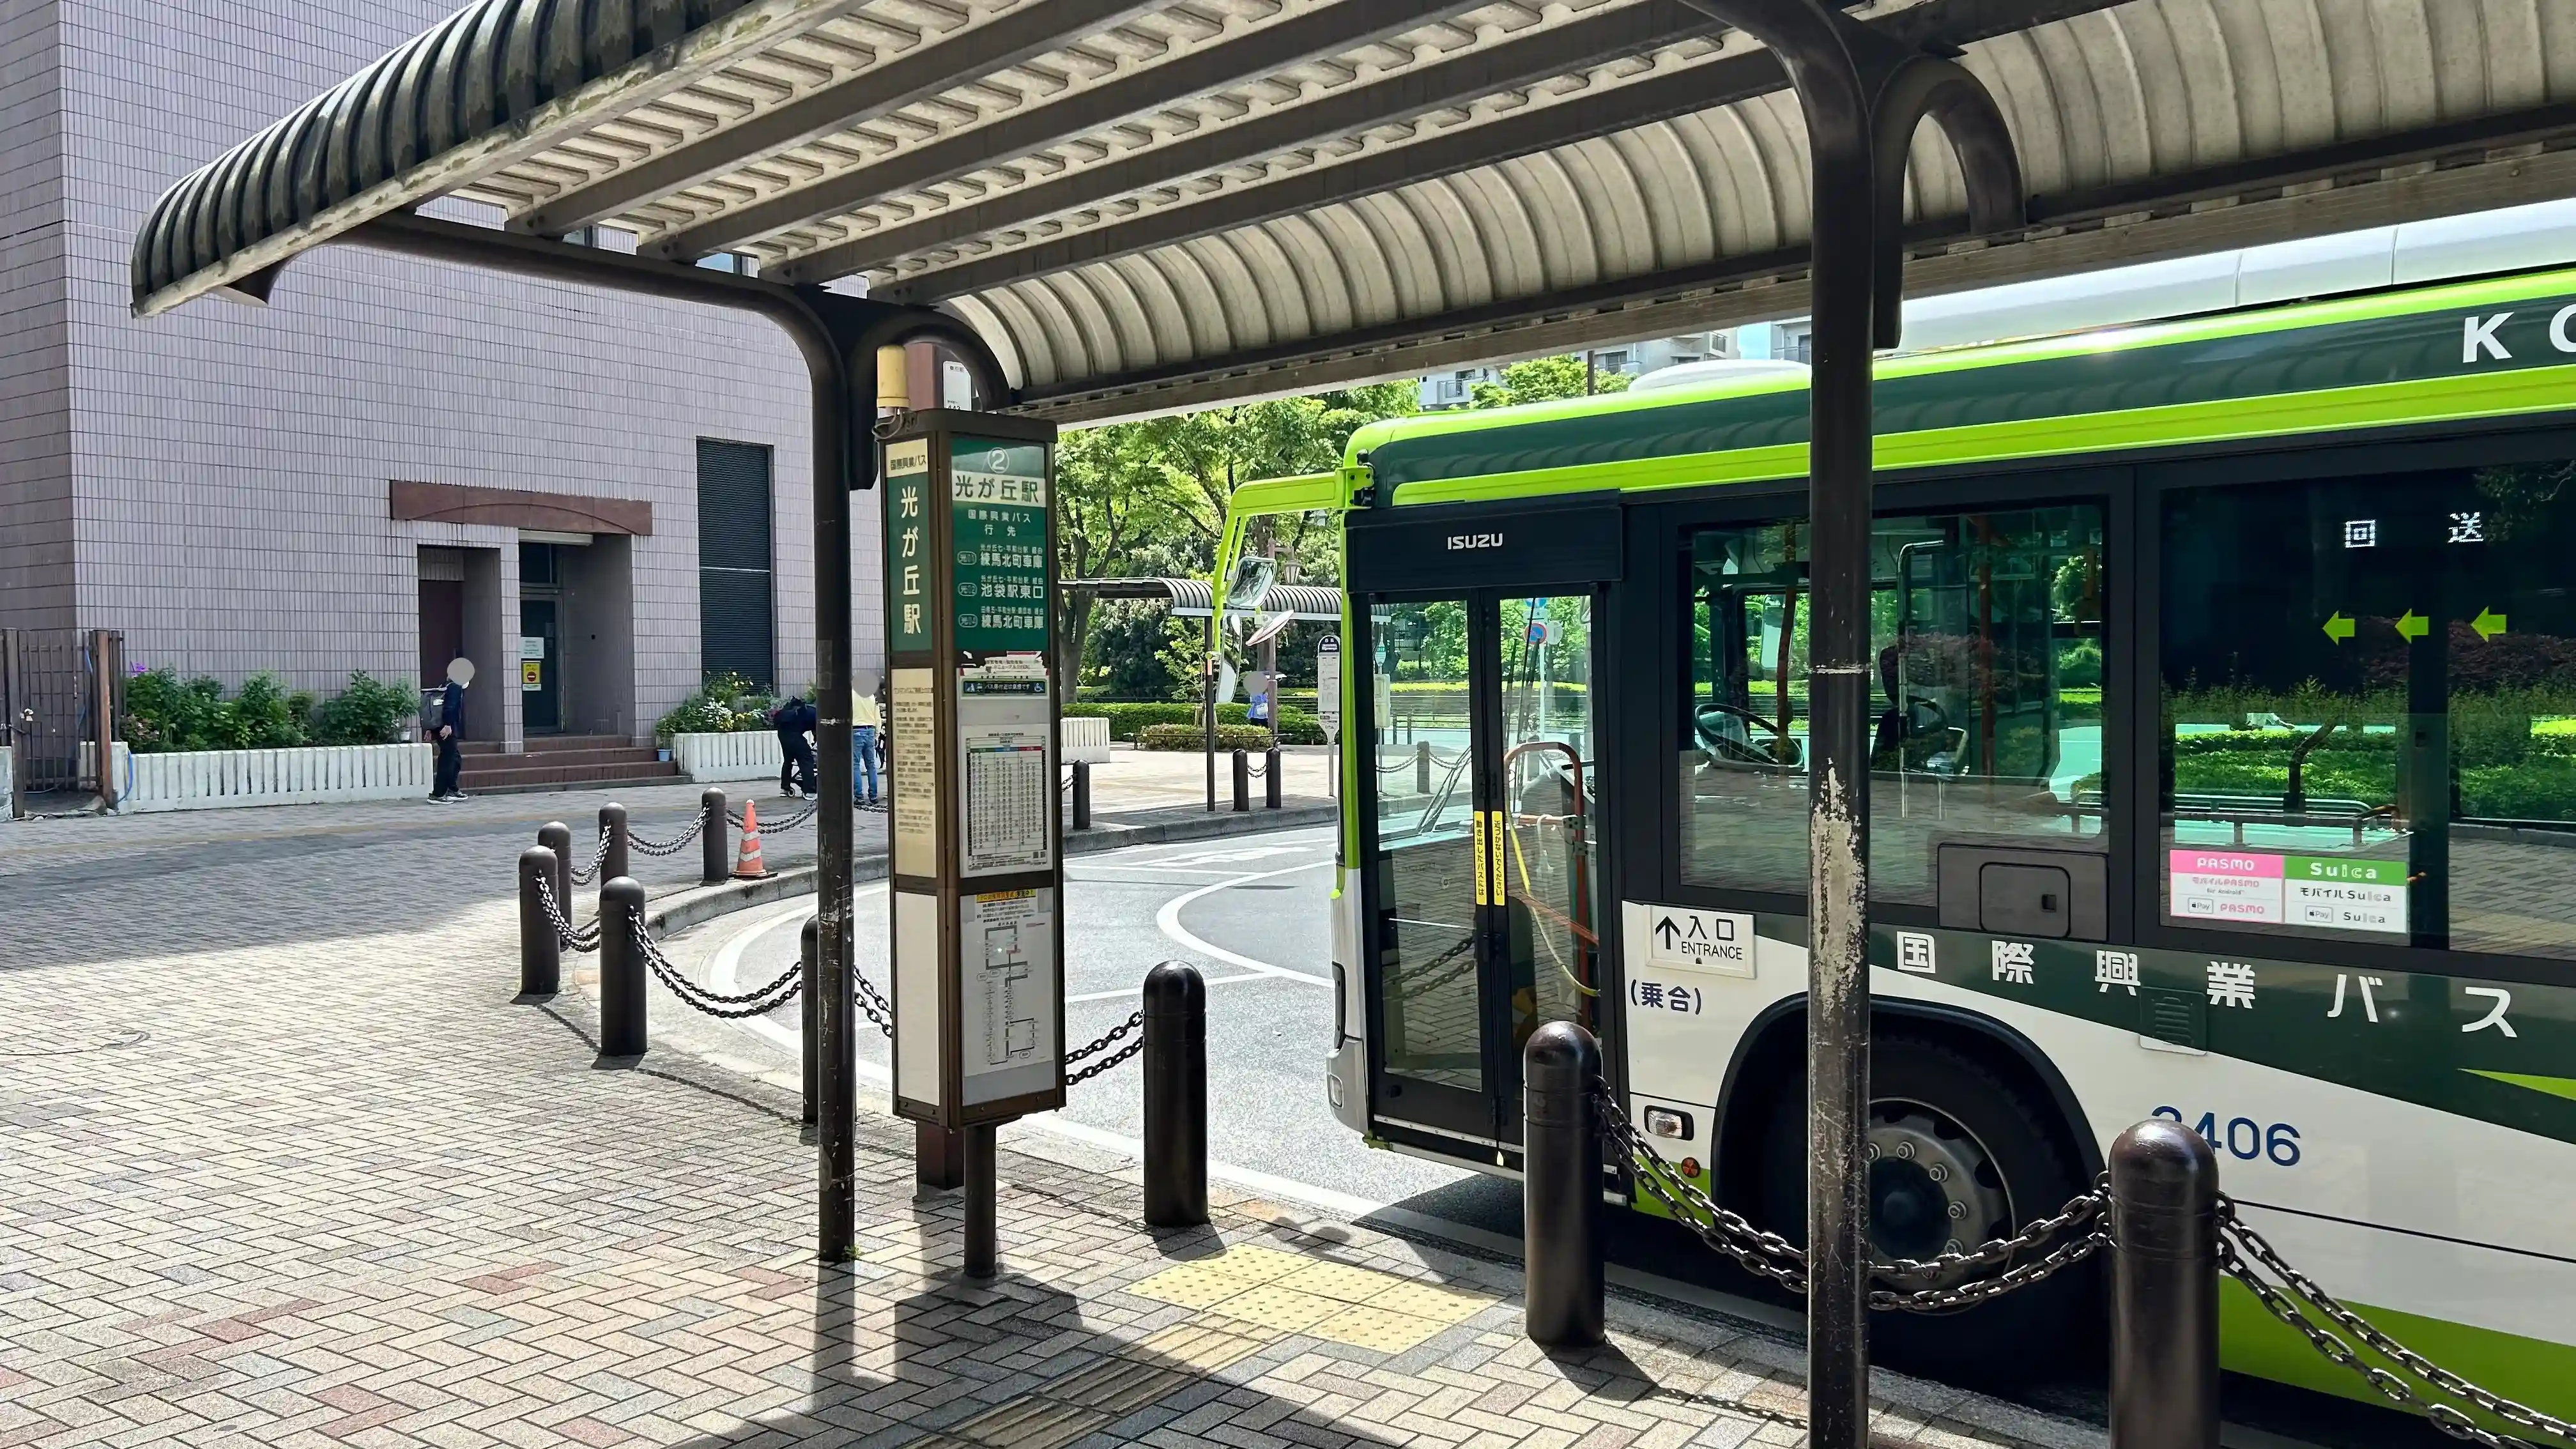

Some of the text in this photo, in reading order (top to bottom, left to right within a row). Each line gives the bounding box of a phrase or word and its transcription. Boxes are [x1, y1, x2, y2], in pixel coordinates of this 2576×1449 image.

[955, 475, 1039, 503] 光が丘駅
[985, 524, 1016, 537] 行先
[2345, 511, 2484, 548] 回送
[1448, 533, 1503, 549] ISUZU
[901, 486, 921, 634] 光が丘駅
[980, 551, 1043, 569] 練馬北町車庫
[981, 583, 1043, 599] 池袋駅東口
[981, 614, 1043, 629] 練馬北町車庫
[1476, 820, 1485, 896] 動き出したバスには
[1494, 820, 1503, 896] 近づかないでください
[2197, 857, 2255, 871] PASMO
[2310, 862, 2377, 879] Suica
[2192, 877, 2260, 887] モバイルPASMO
[2300, 887, 2391, 902] モバイルSuica
[2197, 902, 2265, 914] Pay PASMO
[2315, 910, 2386, 923] Pay Suica
[1687, 915, 1734, 941] 入口
[1681, 941, 1743, 960] ENTRANCE
[1896, 931, 2517, 1038] 国際興業バス
[1630, 979, 1702, 1015] (乗合)
